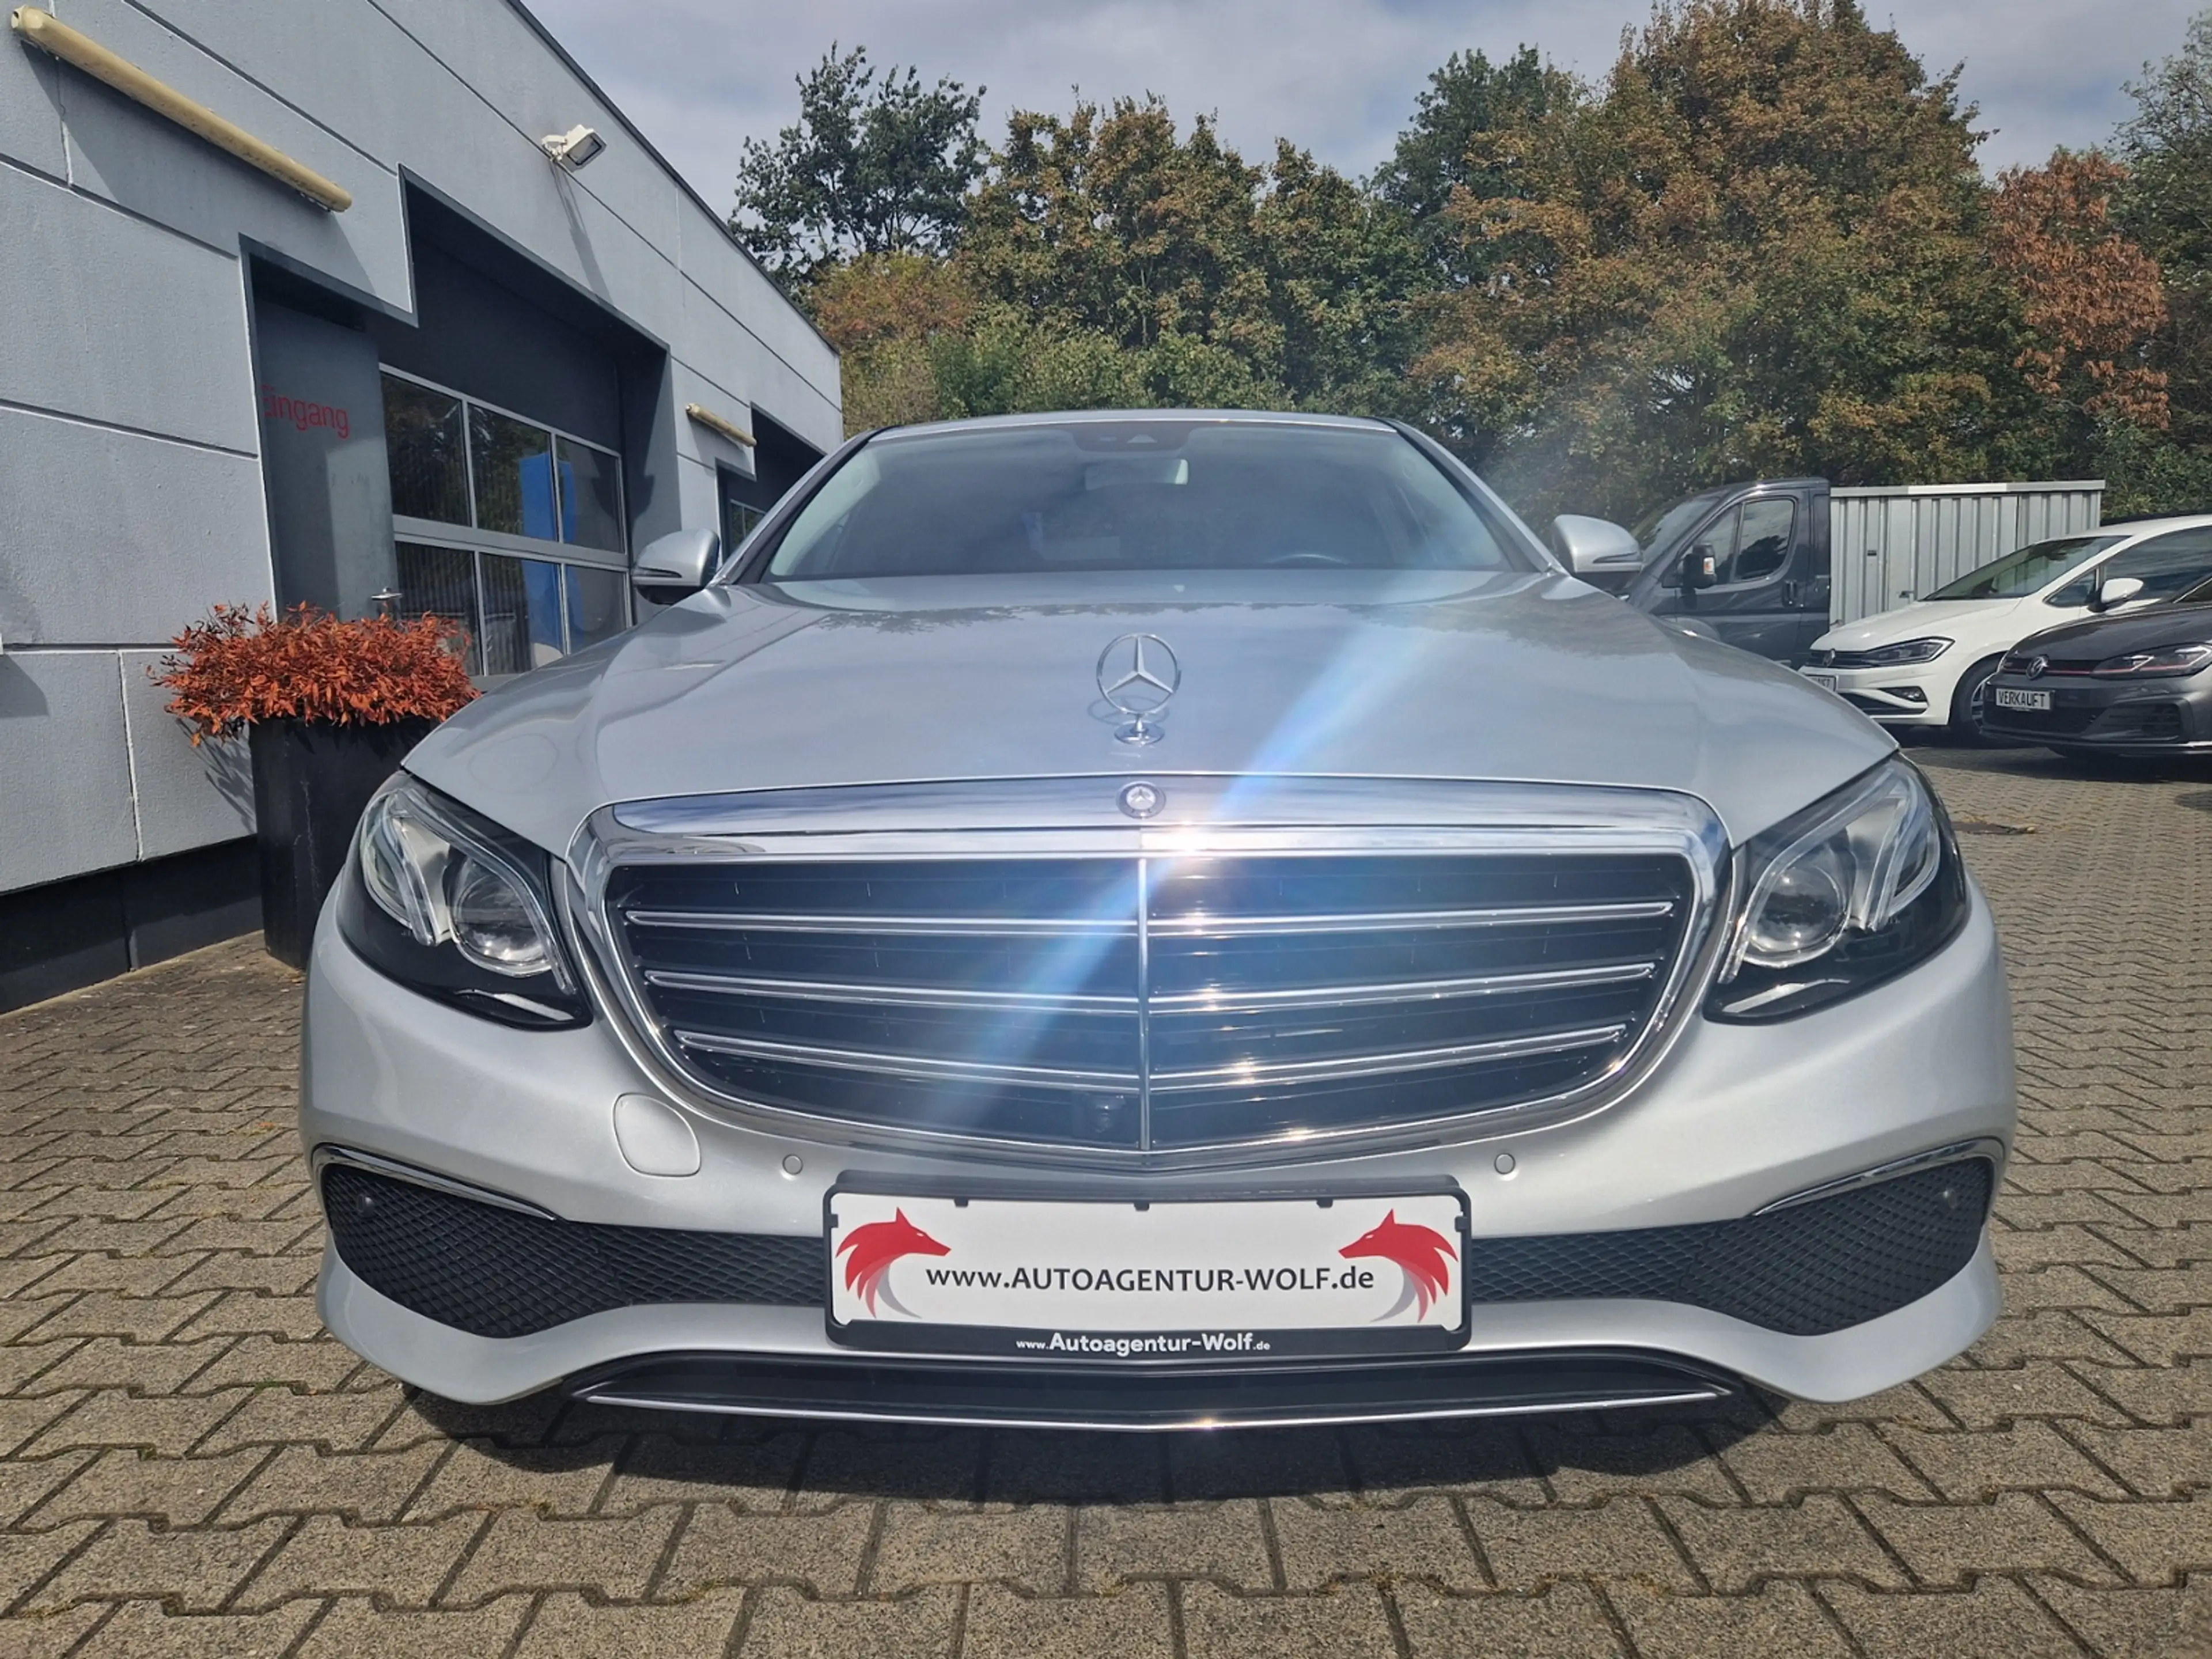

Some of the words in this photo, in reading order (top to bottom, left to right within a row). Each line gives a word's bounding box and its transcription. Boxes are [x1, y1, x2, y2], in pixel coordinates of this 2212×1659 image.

[1999, 691, 2046, 707] VERKAUFT
[926, 1266, 1374, 1291] www.AUTOAGENTUR-WOLF.de
[1016, 1332, 1271, 1357] www.Autoagentur-Wolf.de
